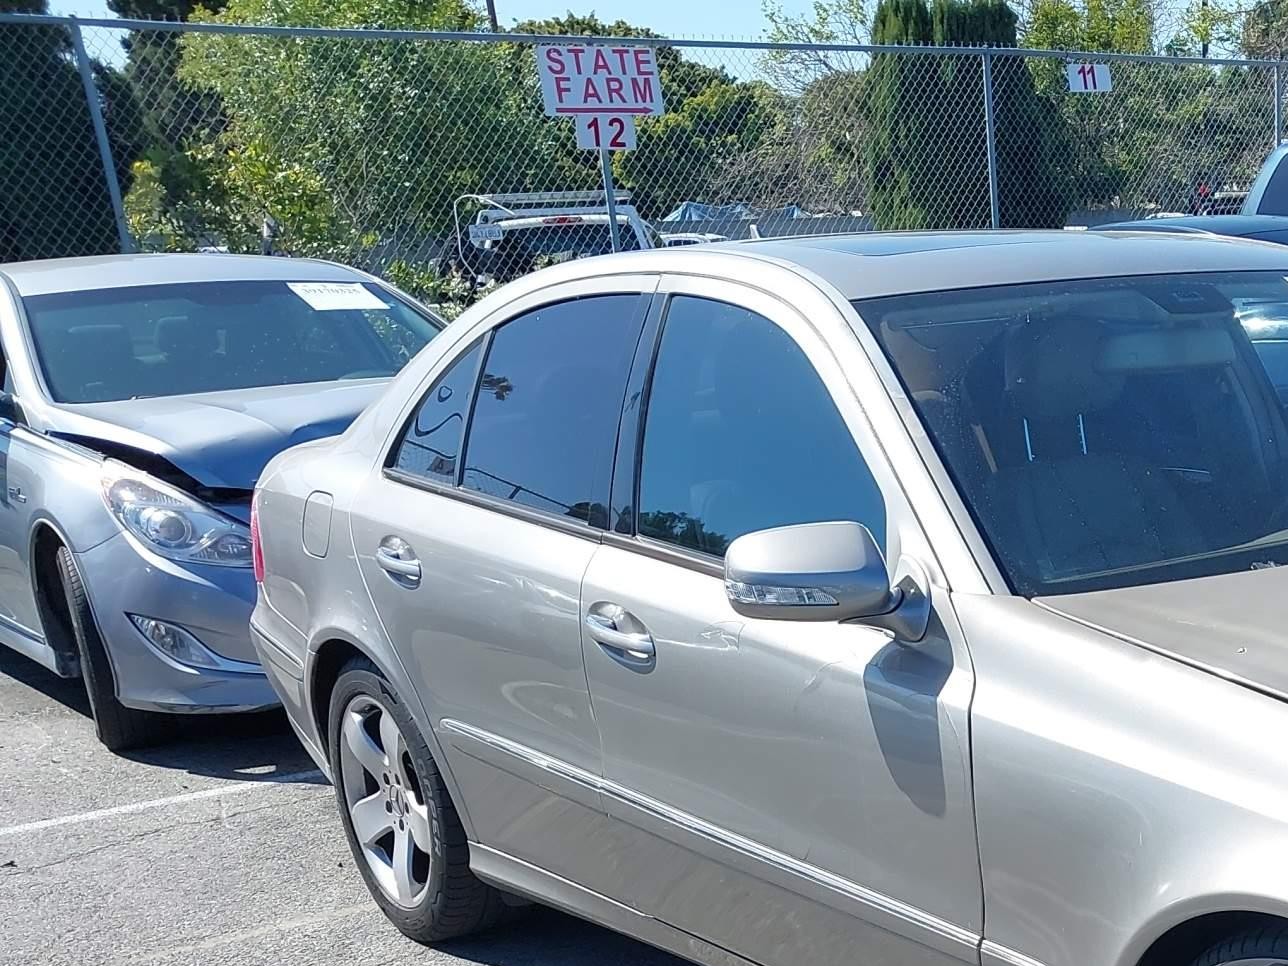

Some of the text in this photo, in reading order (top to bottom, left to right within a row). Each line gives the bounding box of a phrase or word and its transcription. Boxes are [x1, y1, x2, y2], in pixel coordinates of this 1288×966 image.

[546, 47, 654, 76] STATE
[554, 76, 654, 104] FARM
[1077, 65, 1097, 90] 11
[586, 117, 627, 148] 12
[416, 757, 442, 857] OOPER
